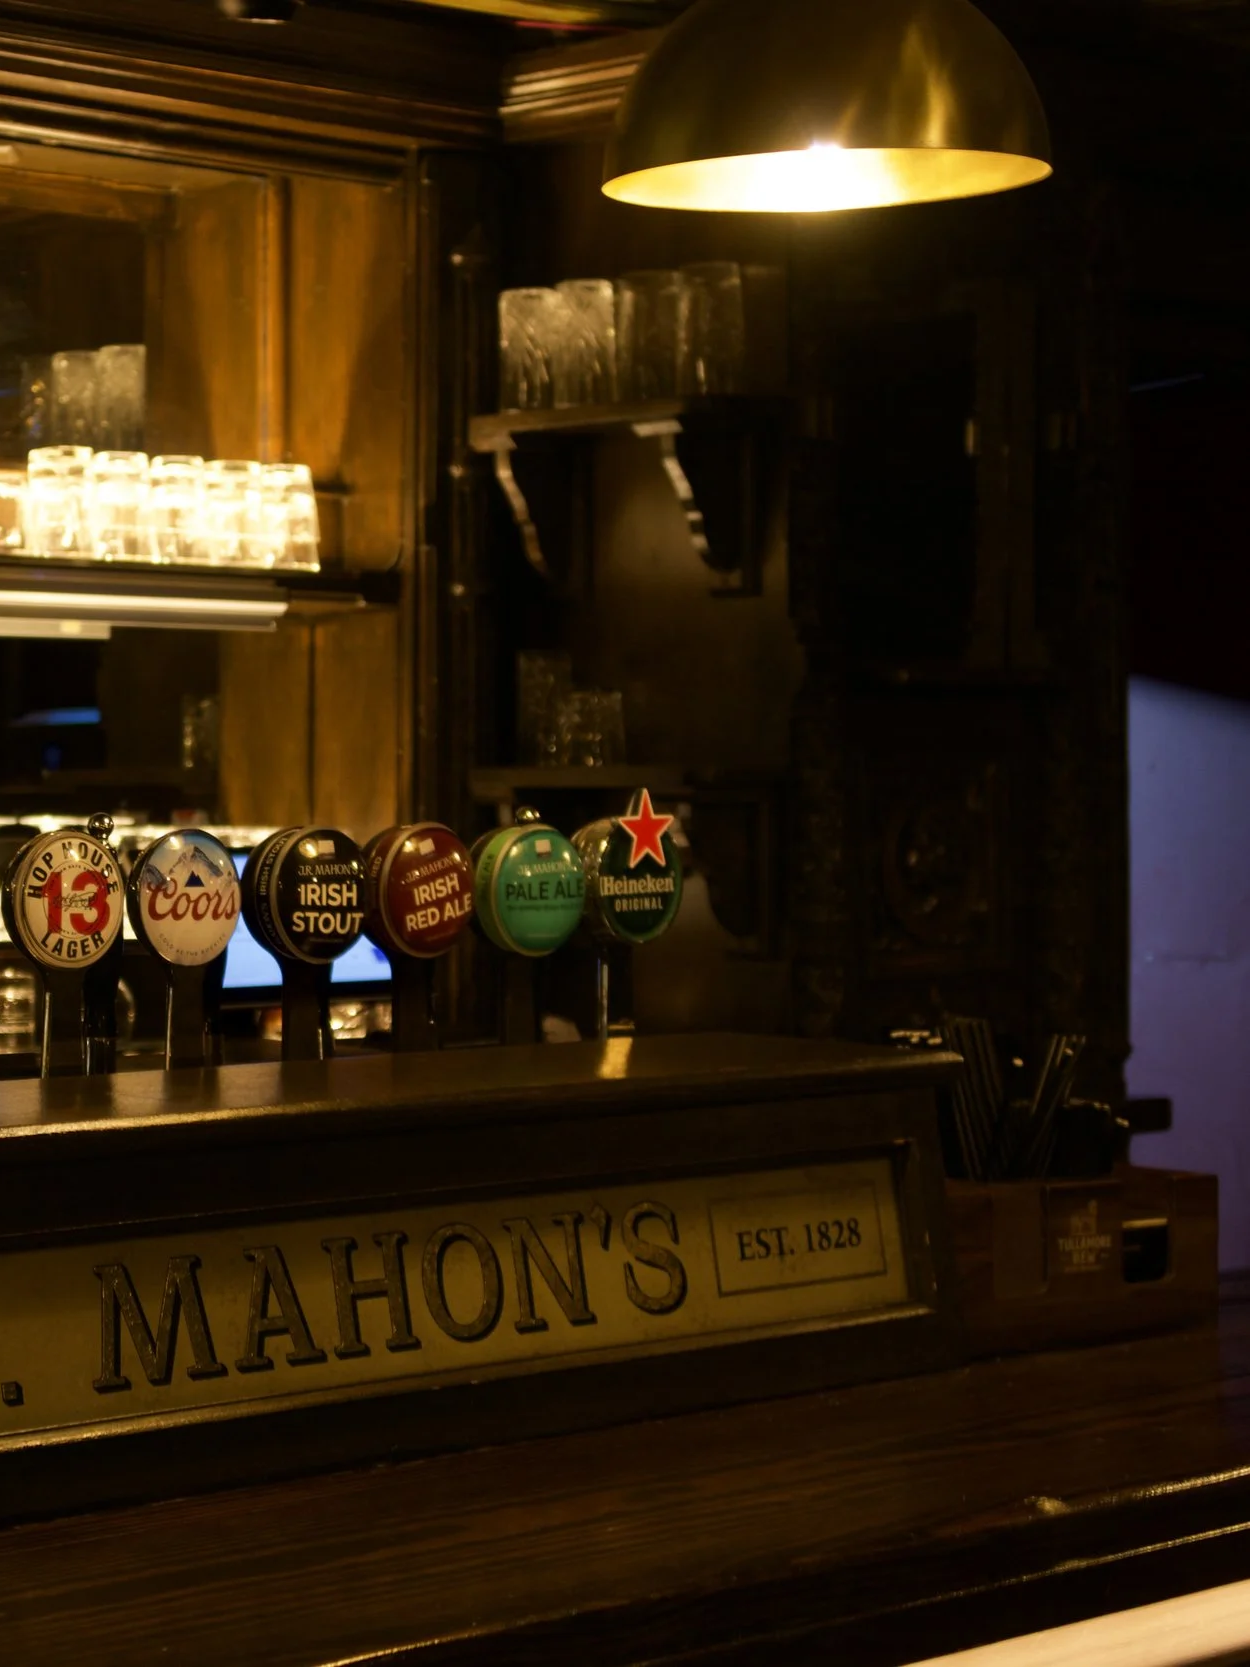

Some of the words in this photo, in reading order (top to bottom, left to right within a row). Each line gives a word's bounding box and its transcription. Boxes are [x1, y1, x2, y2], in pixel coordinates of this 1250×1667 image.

[27, 852, 54, 898] HOP
[62, 841, 119, 895] HOUSE
[259, 866, 270, 896] IRISH
[600, 872, 674, 897] Heineken
[42, 870, 110, 935] 13
[147, 878, 236, 921] Coors
[299, 883, 358, 907] IRISH
[413, 872, 460, 906] IRISH
[505, 881, 549, 900] PALE
[554, 877, 584, 899] ALE
[614, 896, 663, 912] ORIGINAL
[291, 911, 364, 935] STOUT
[405, 906, 440, 932] RED
[443, 892, 472, 922] ALE
[41, 930, 105, 958] LAGER
[737, 1228, 798, 1263] EST.
[802, 1217, 863, 1255] 1828
[92, 1200, 689, 1394] MAHON'S
